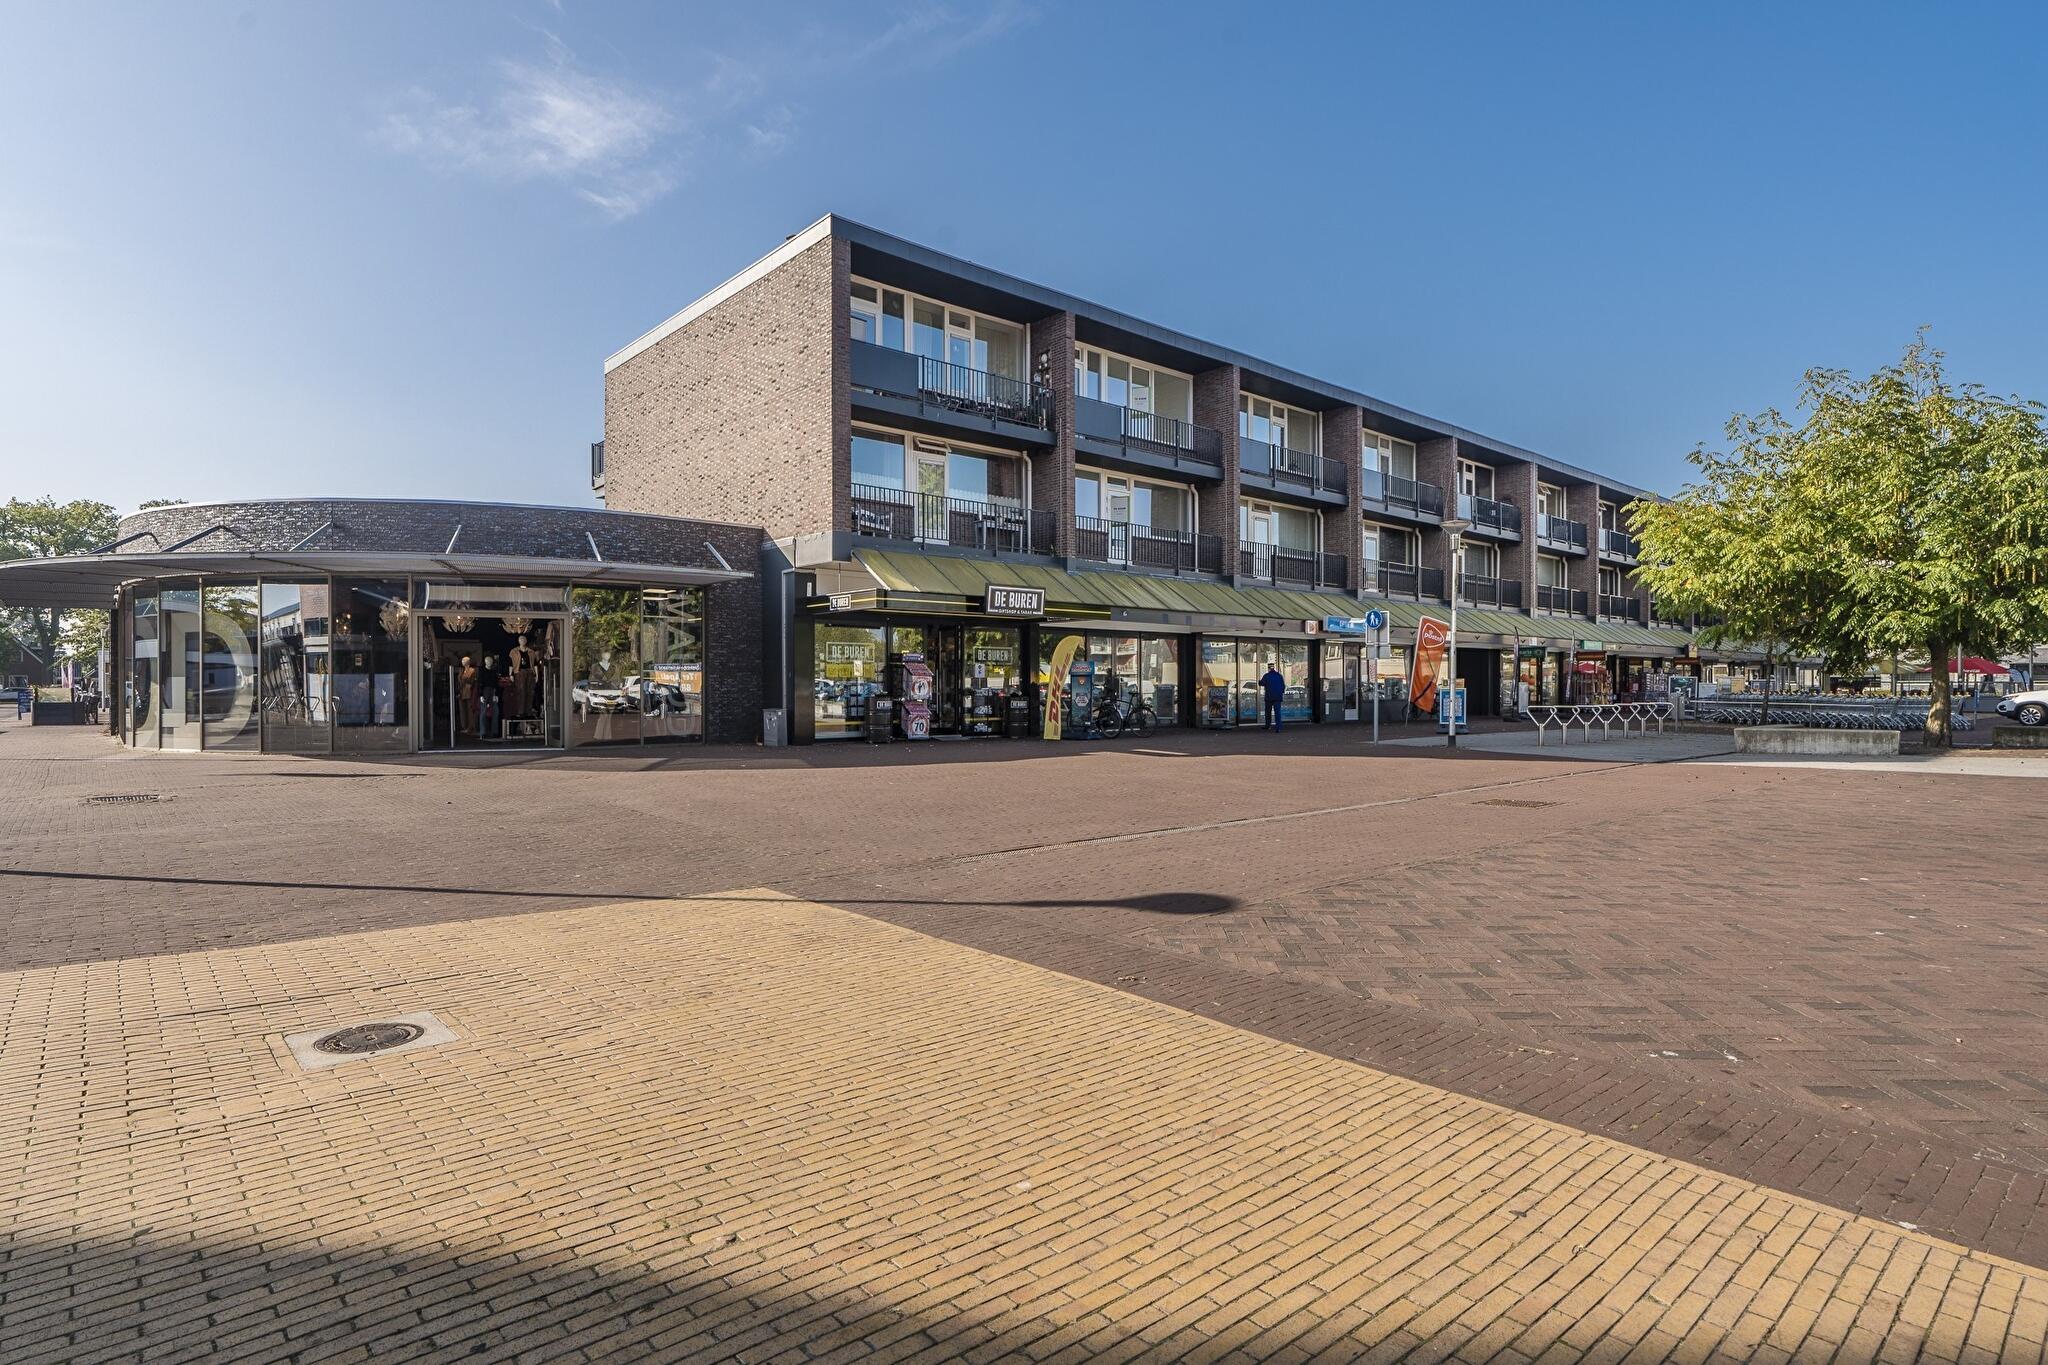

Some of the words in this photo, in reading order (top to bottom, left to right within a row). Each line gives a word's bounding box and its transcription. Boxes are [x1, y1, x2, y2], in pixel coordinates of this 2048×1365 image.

[832, 598, 837, 608] DE
[995, 591, 1006, 607] DE
[1008, 592, 1038, 609] BUREN
[832, 645, 842, 658] DE
[844, 645, 870, 659] BUREN
[978, 649, 987, 660] DE
[987, 649, 1009, 661] BUREN
[914, 722, 924, 732] 70
